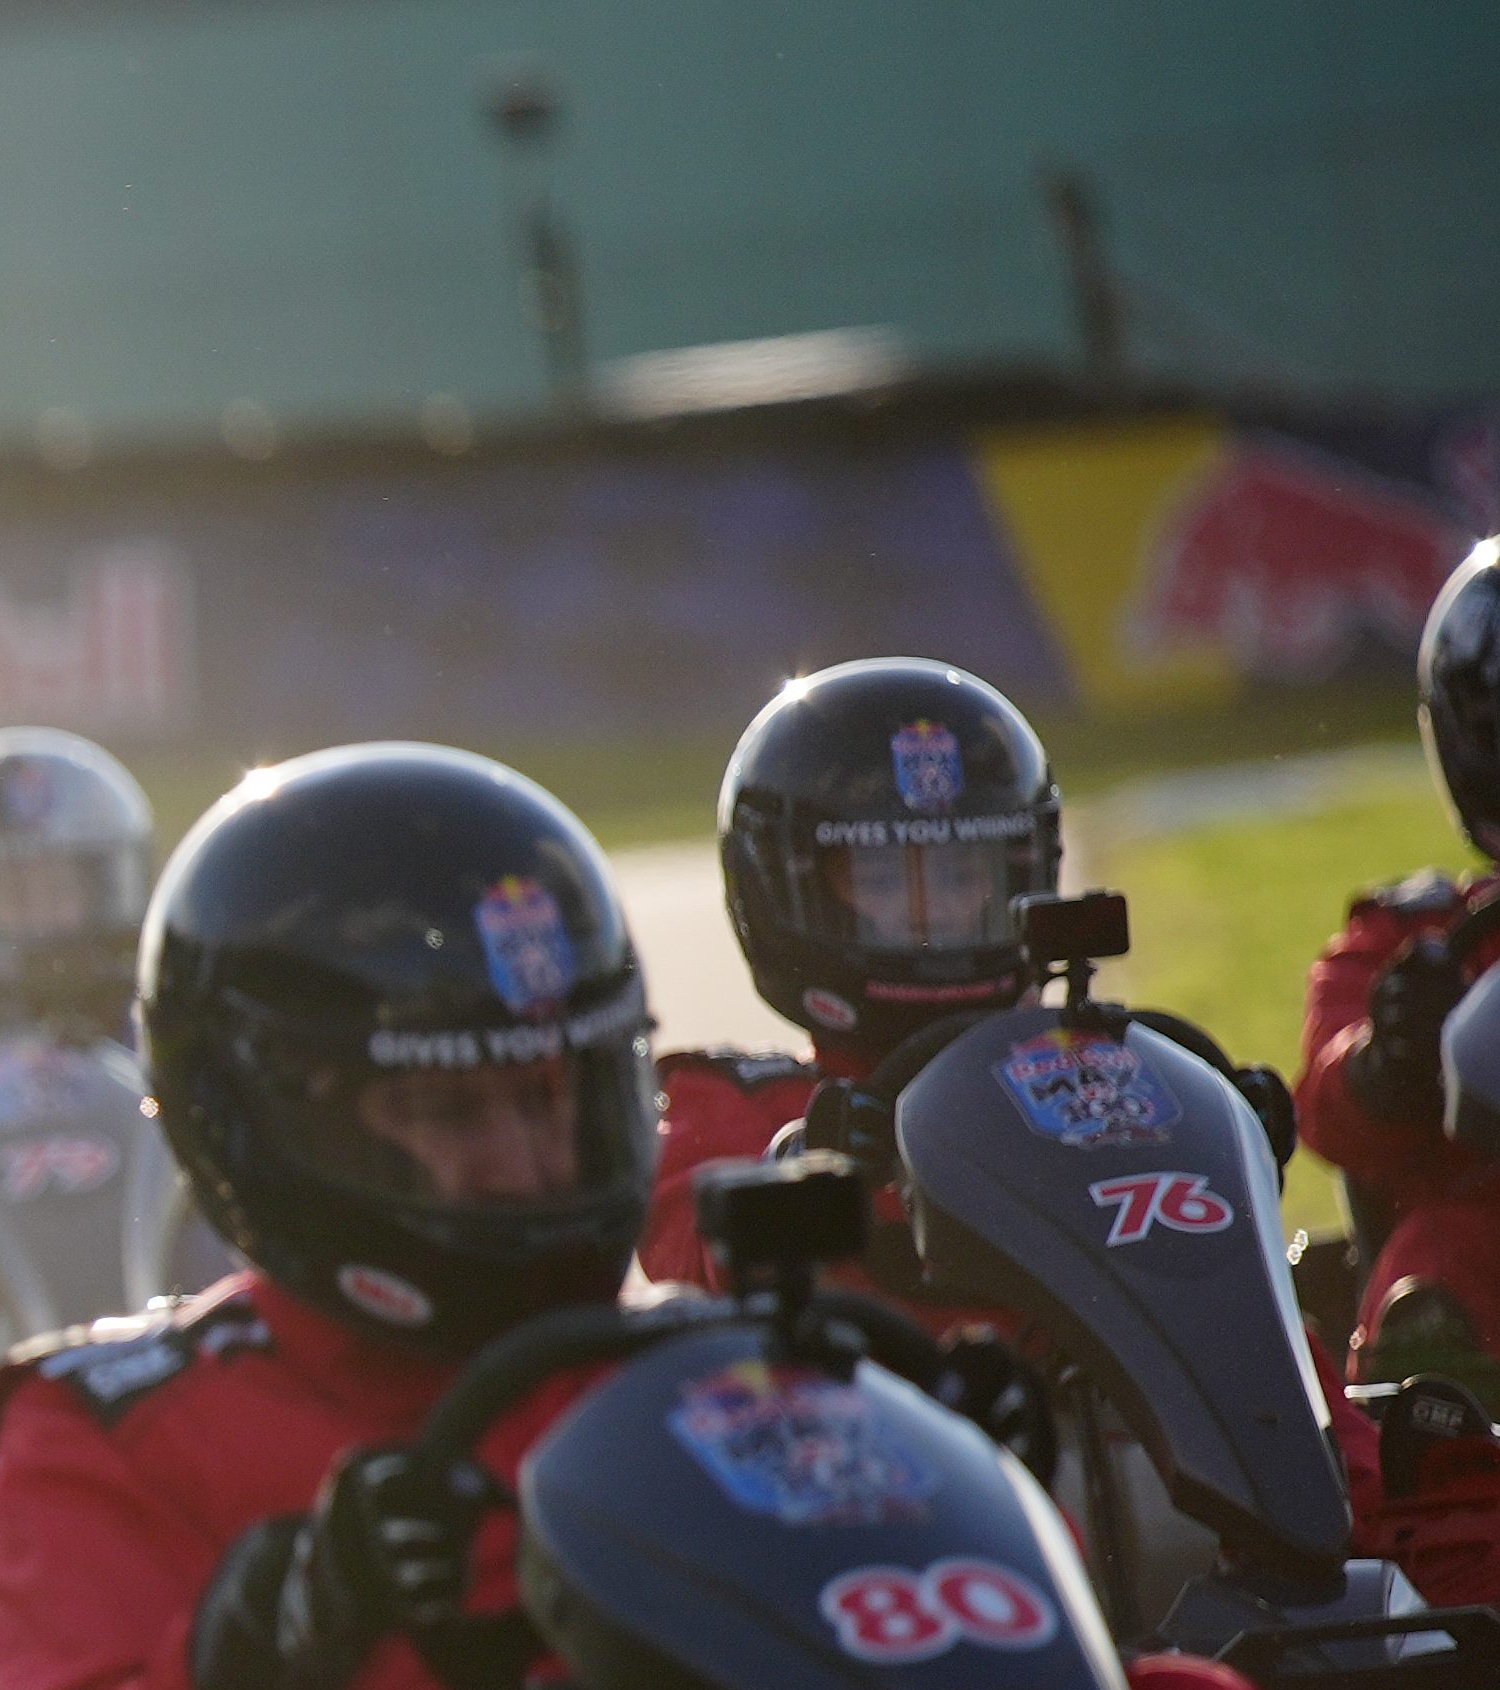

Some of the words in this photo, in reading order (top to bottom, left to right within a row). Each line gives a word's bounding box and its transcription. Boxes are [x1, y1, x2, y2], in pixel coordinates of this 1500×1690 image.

[893, 818, 951, 844] YOU
[1088, 1171, 1235, 1248] 76
[818, 1555, 1058, 1664] 80
